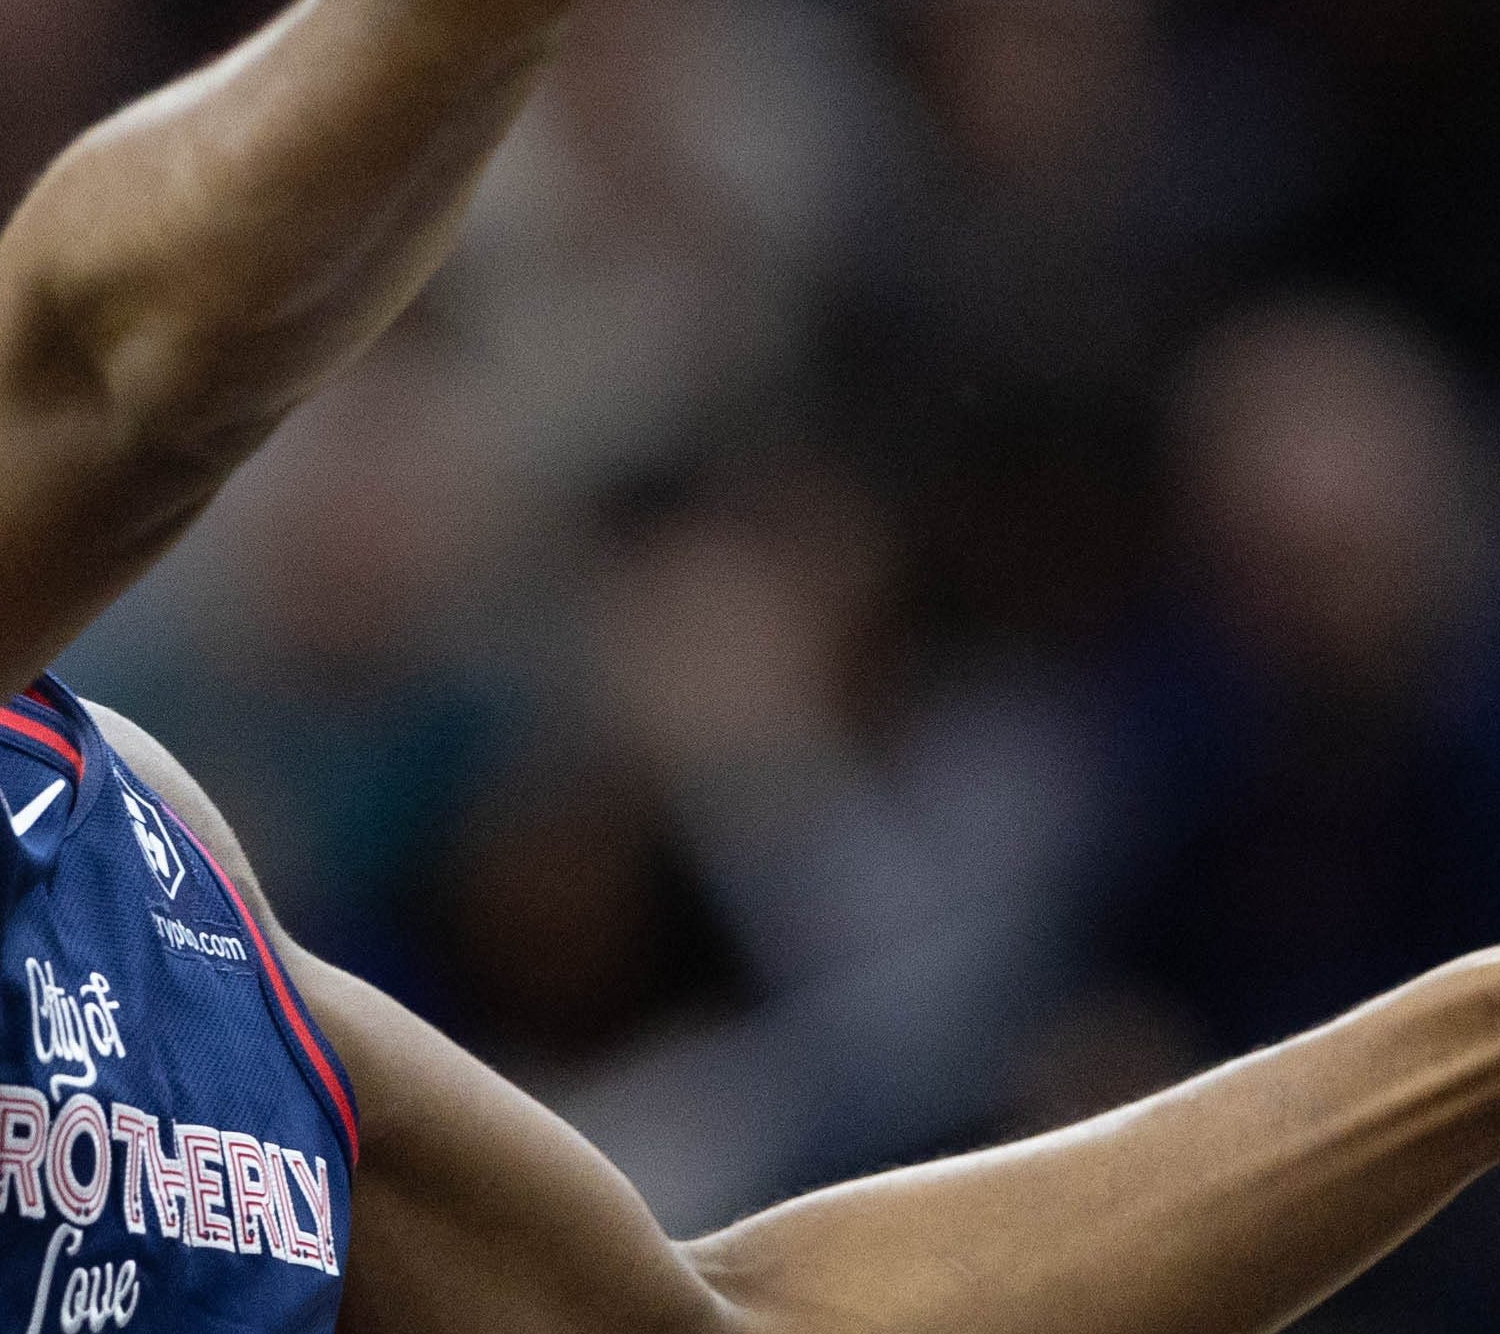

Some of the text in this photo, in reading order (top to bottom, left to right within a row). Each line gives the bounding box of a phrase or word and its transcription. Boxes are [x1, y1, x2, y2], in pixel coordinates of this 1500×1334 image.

[153, 914, 247, 961] rypto.com
[25, 957, 126, 1102] City of
